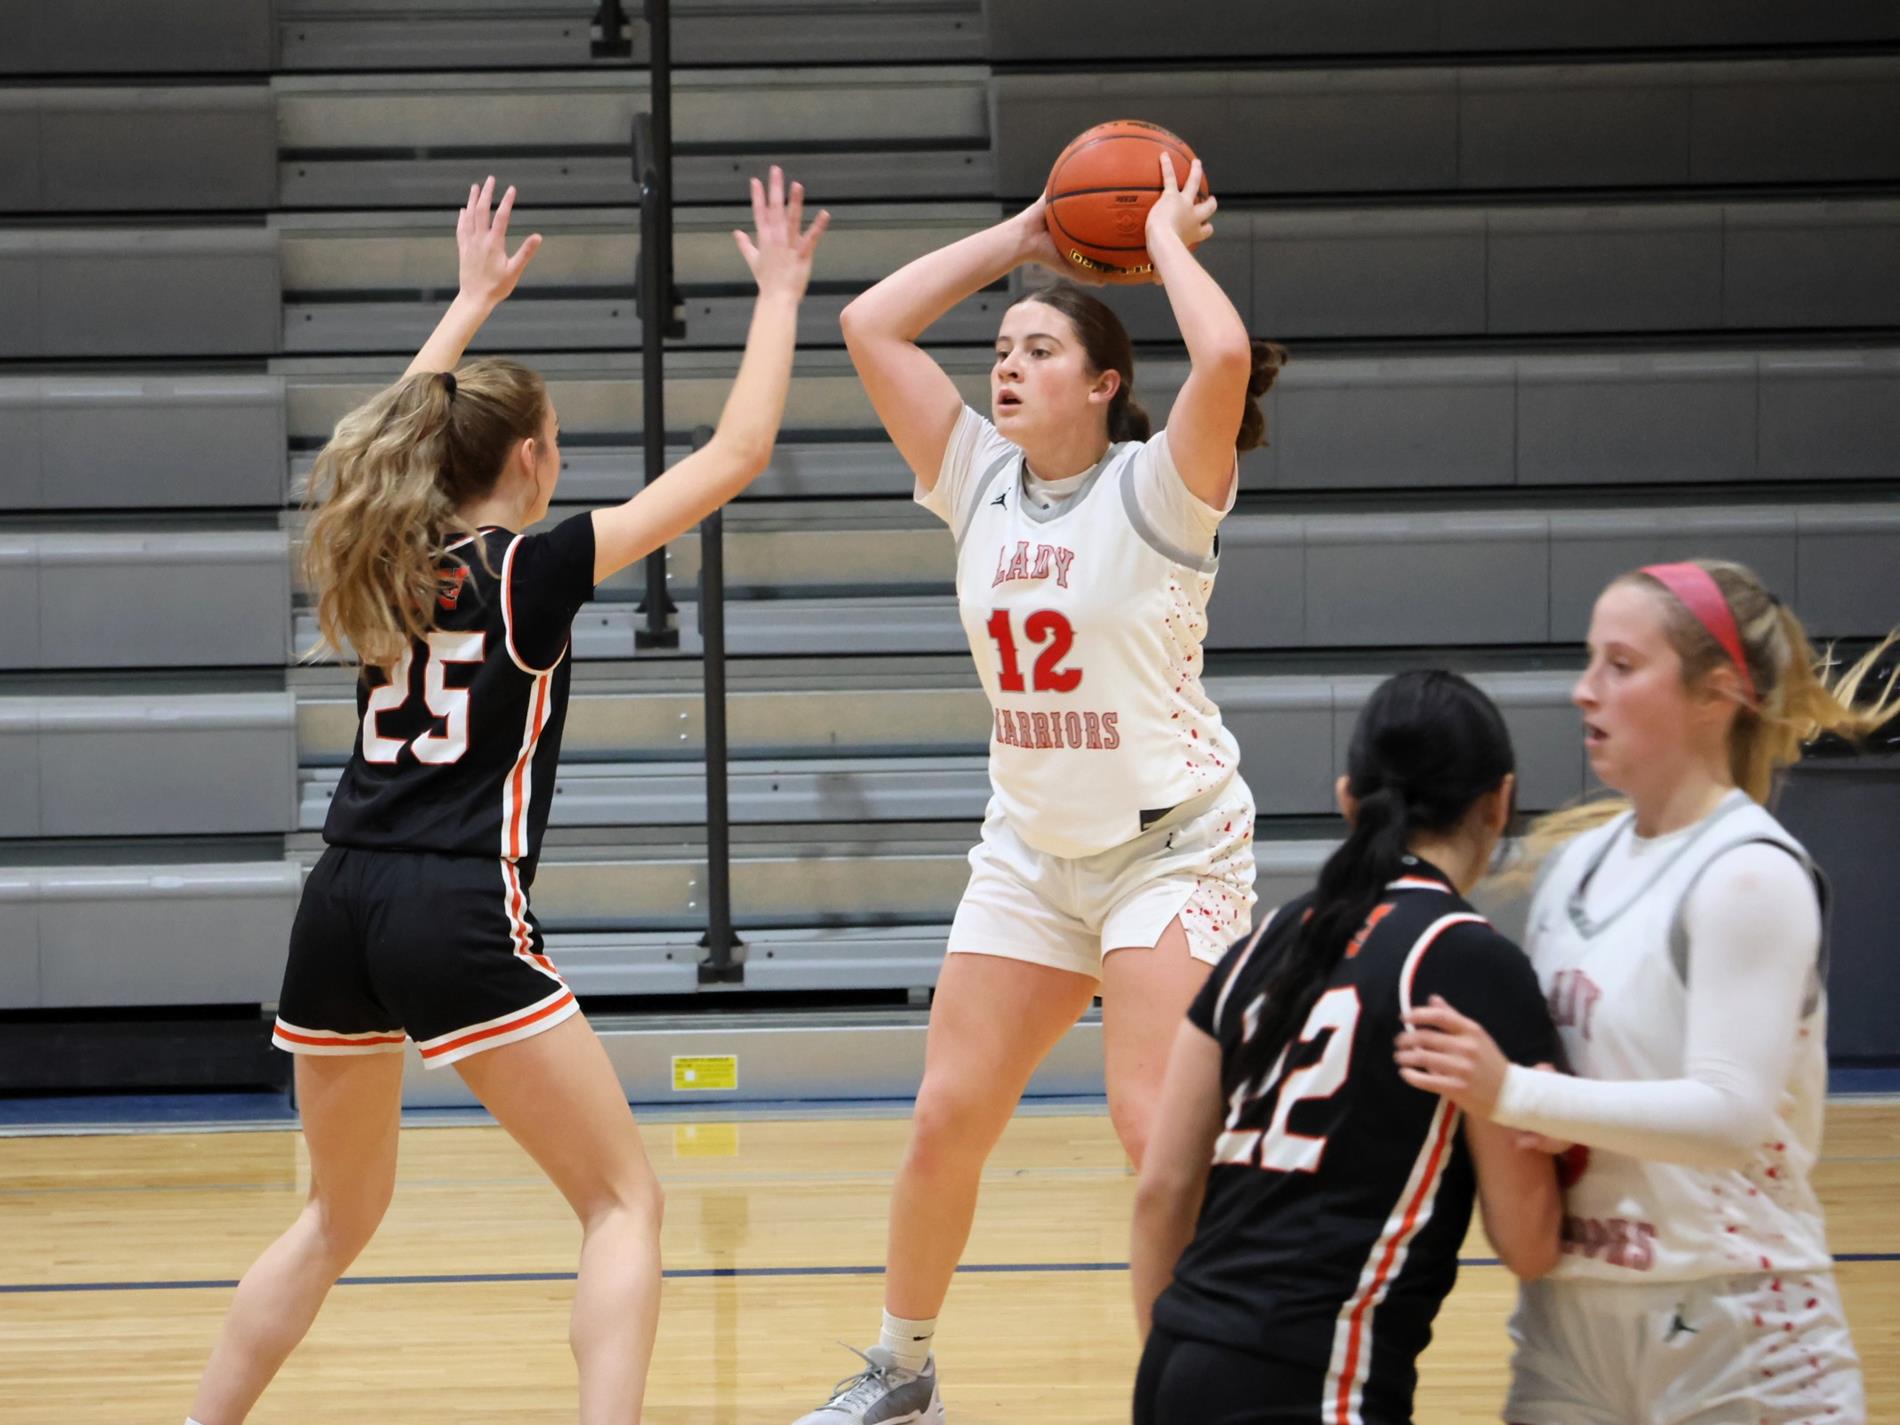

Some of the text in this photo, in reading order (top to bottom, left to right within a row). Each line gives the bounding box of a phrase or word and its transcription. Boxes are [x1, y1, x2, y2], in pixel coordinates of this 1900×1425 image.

[993, 541, 1075, 588] LADY
[986, 608, 1083, 694] 12
[362, 630, 487, 764] 25
